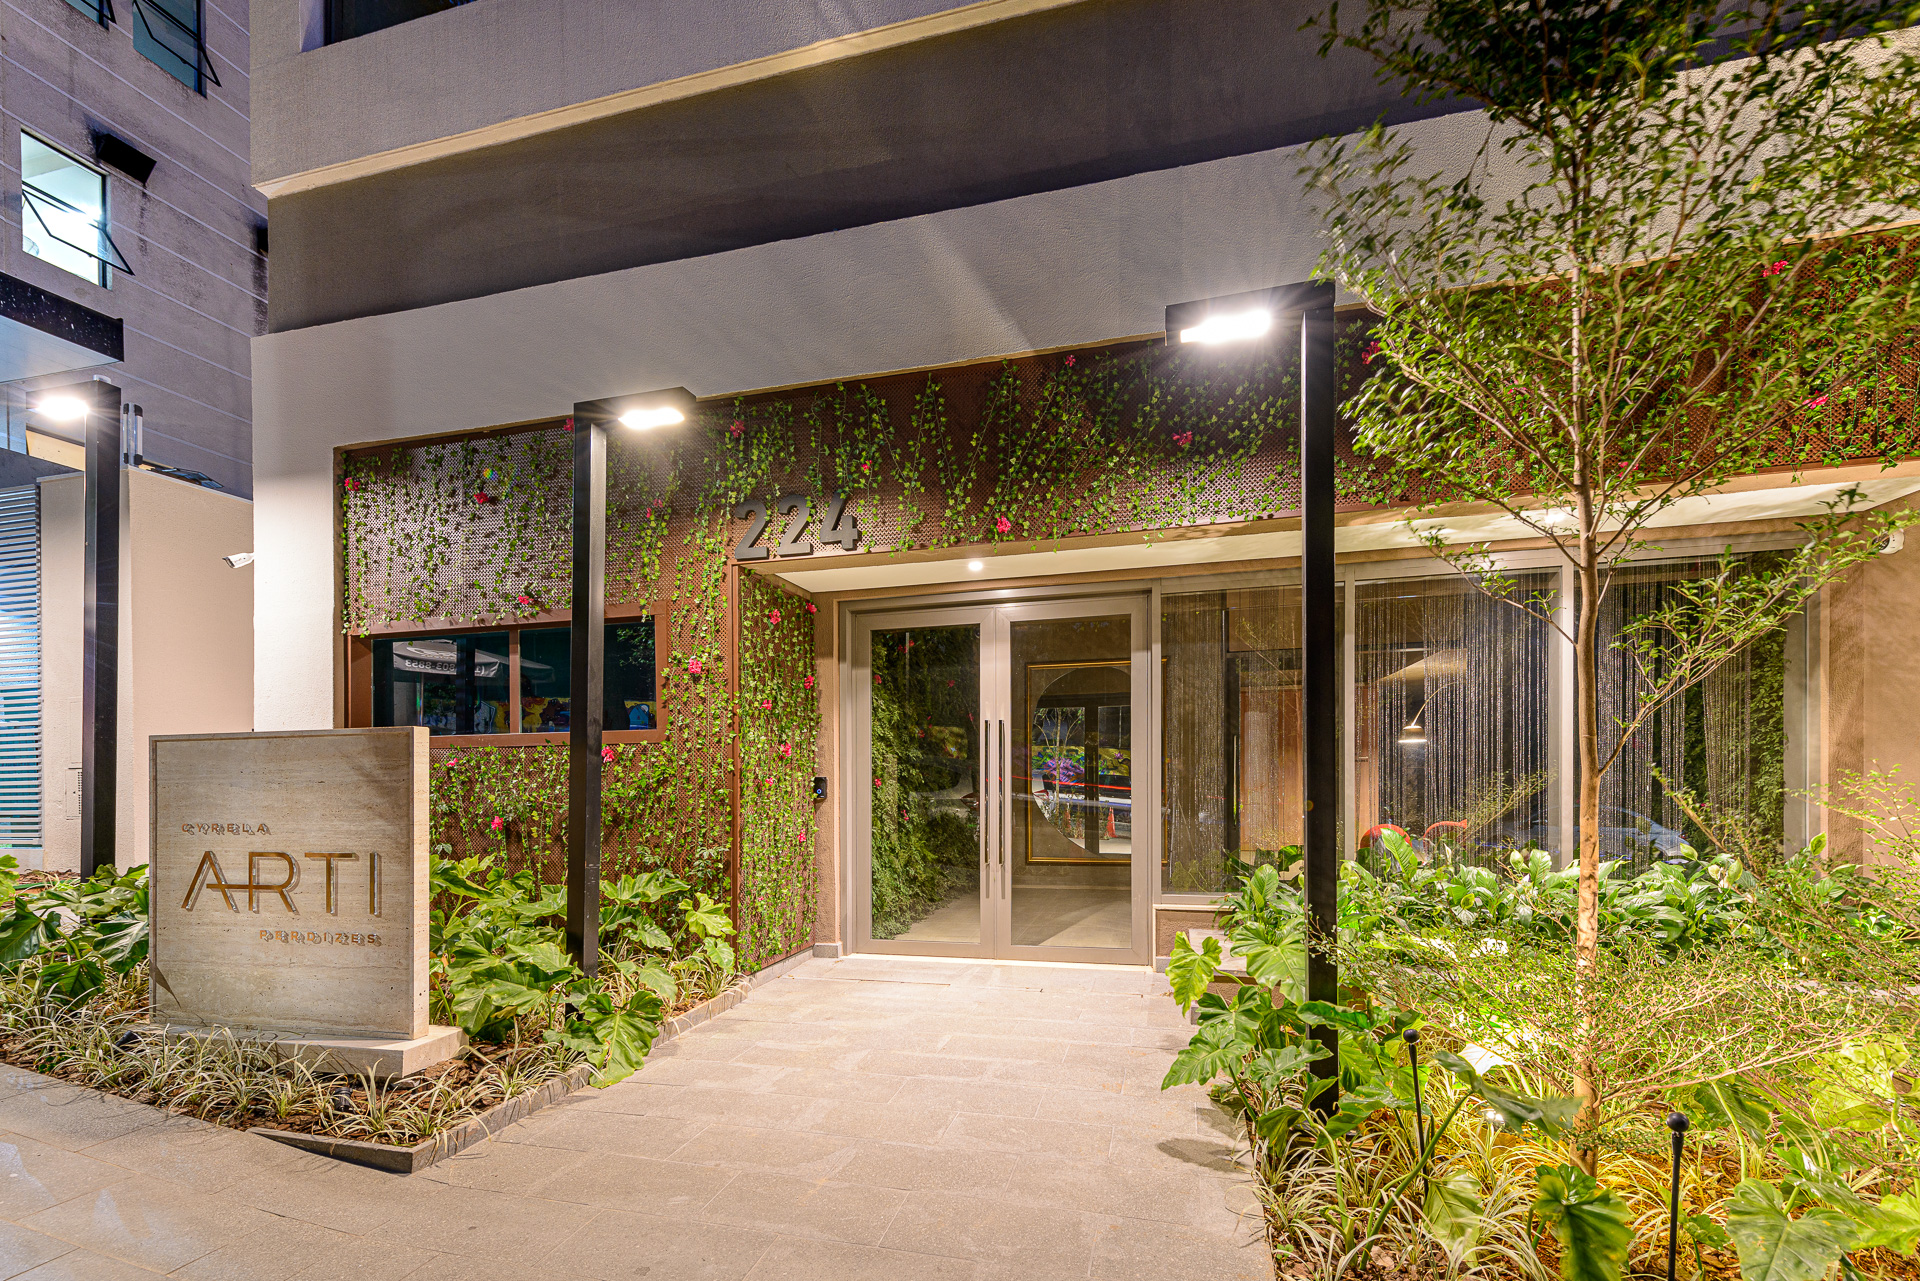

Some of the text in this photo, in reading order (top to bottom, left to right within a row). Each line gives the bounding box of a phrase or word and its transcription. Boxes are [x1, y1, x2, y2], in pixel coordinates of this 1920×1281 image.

[734, 491, 859, 560] 224
[181, 823, 270, 835] CYRELA
[181, 851, 381, 916] ARTI
[259, 929, 381, 946] PERDIZES
